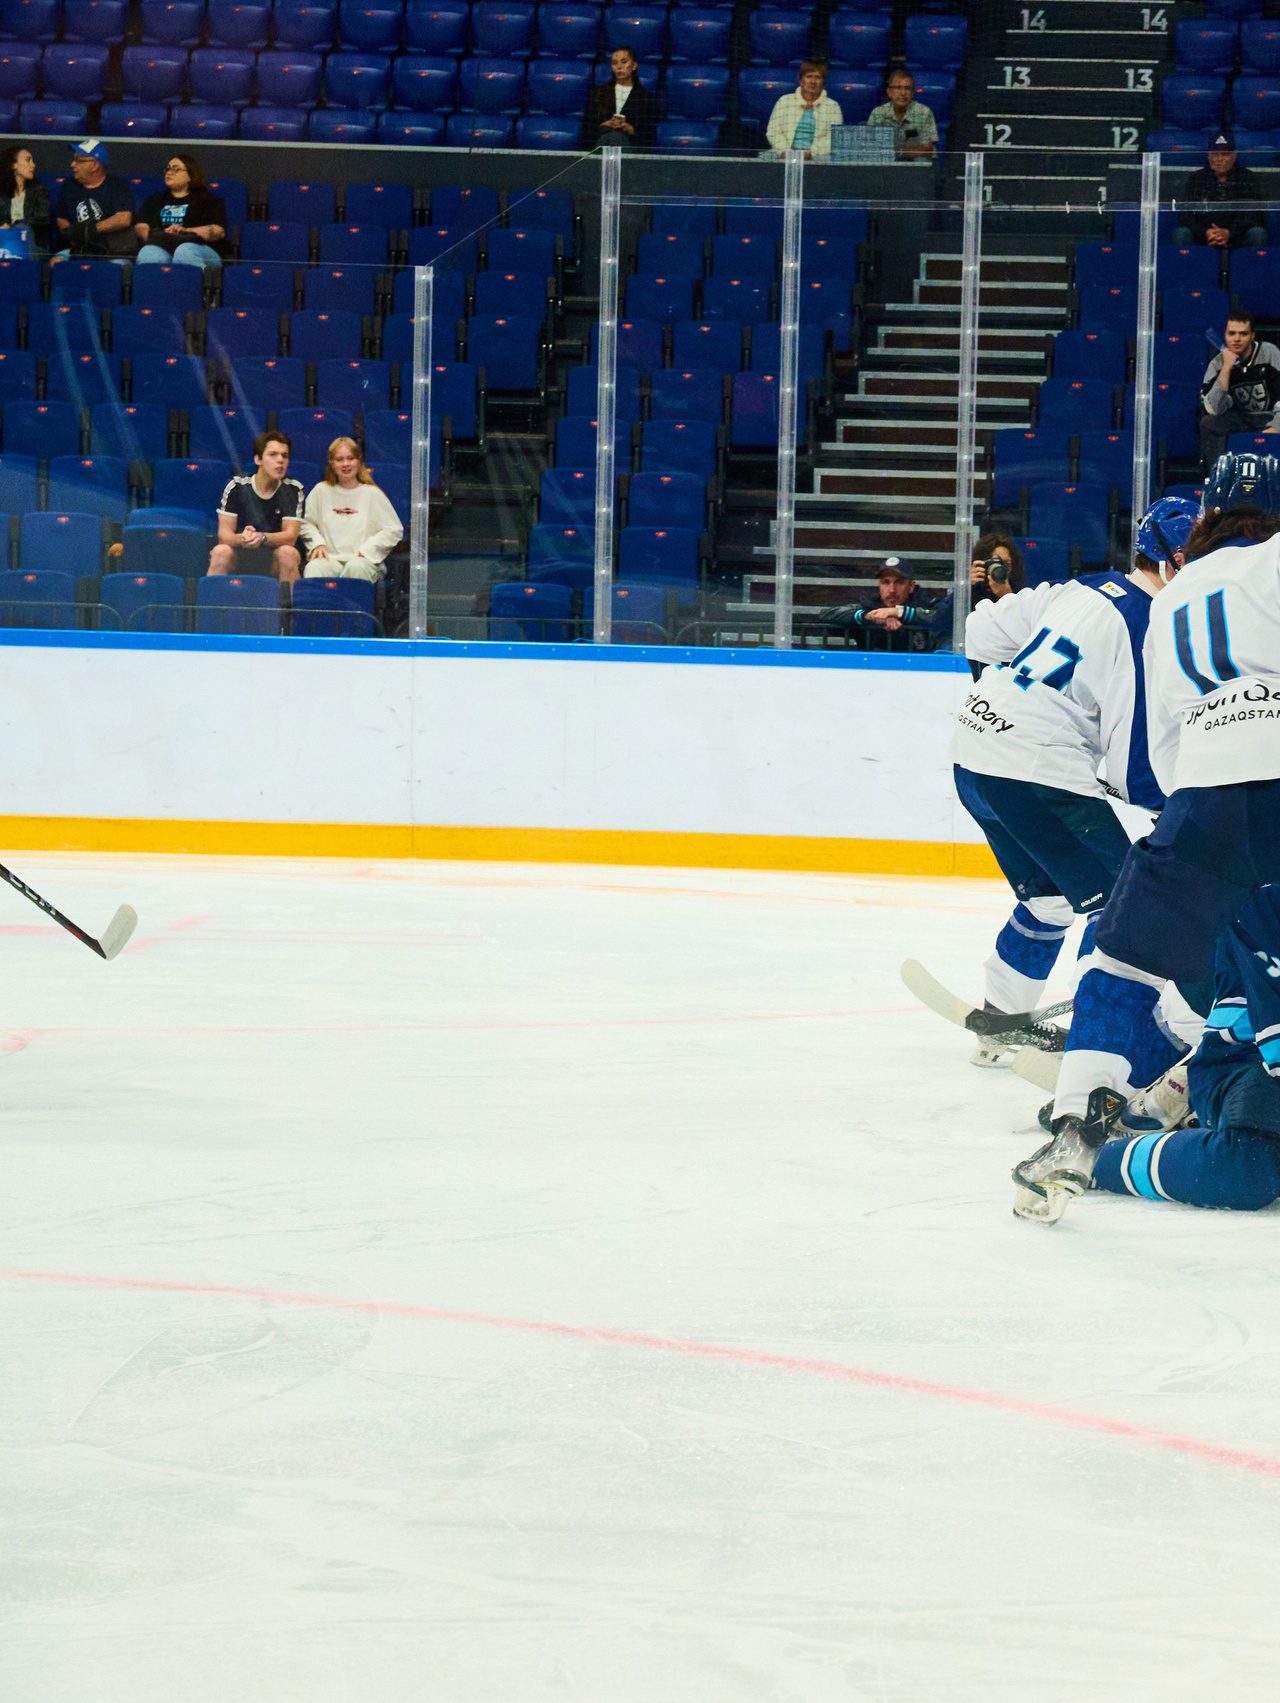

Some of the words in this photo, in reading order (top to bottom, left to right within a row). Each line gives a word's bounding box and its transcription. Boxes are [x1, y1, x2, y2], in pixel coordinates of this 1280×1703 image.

[1020, 9, 1046, 31] 14
[1140, 8, 1168, 30] 14
[1003, 66, 1031, 88] 13
[1125, 69, 1153, 90] 13
[984, 124, 1012, 146] 12
[1111, 126, 1139, 149] 12
[1242, 462, 1255, 477] 11
[1173, 588, 1240, 696] 11
[971, 700, 1015, 733] Qory
